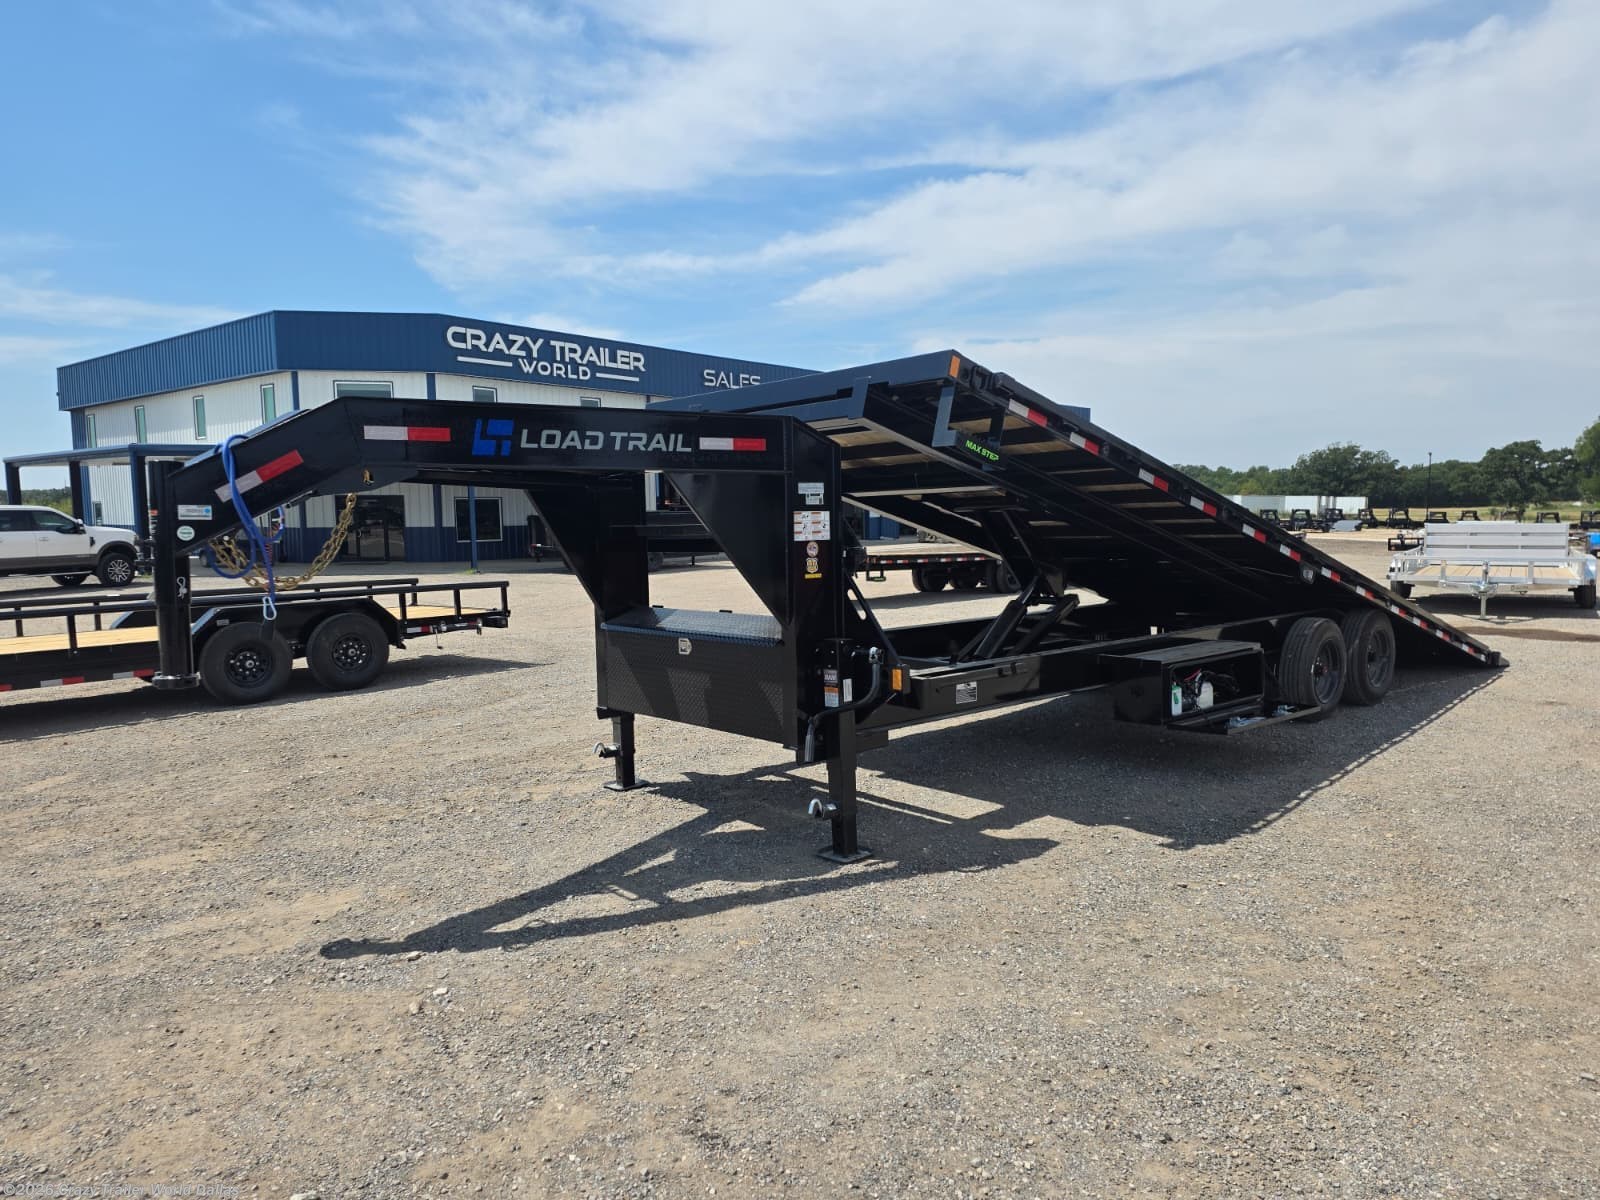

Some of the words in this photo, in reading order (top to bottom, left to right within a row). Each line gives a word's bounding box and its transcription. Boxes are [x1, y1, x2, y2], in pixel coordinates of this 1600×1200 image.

[446, 326, 543, 357] CRAZY
[550, 340, 646, 372] TRAILER
[518, 358, 591, 380] WORLD
[520, 428, 605, 450] LOAD
[610, 431, 692, 453] TRAIL
[966, 440, 982, 454] MAX
[981, 448, 999, 461] STEP
